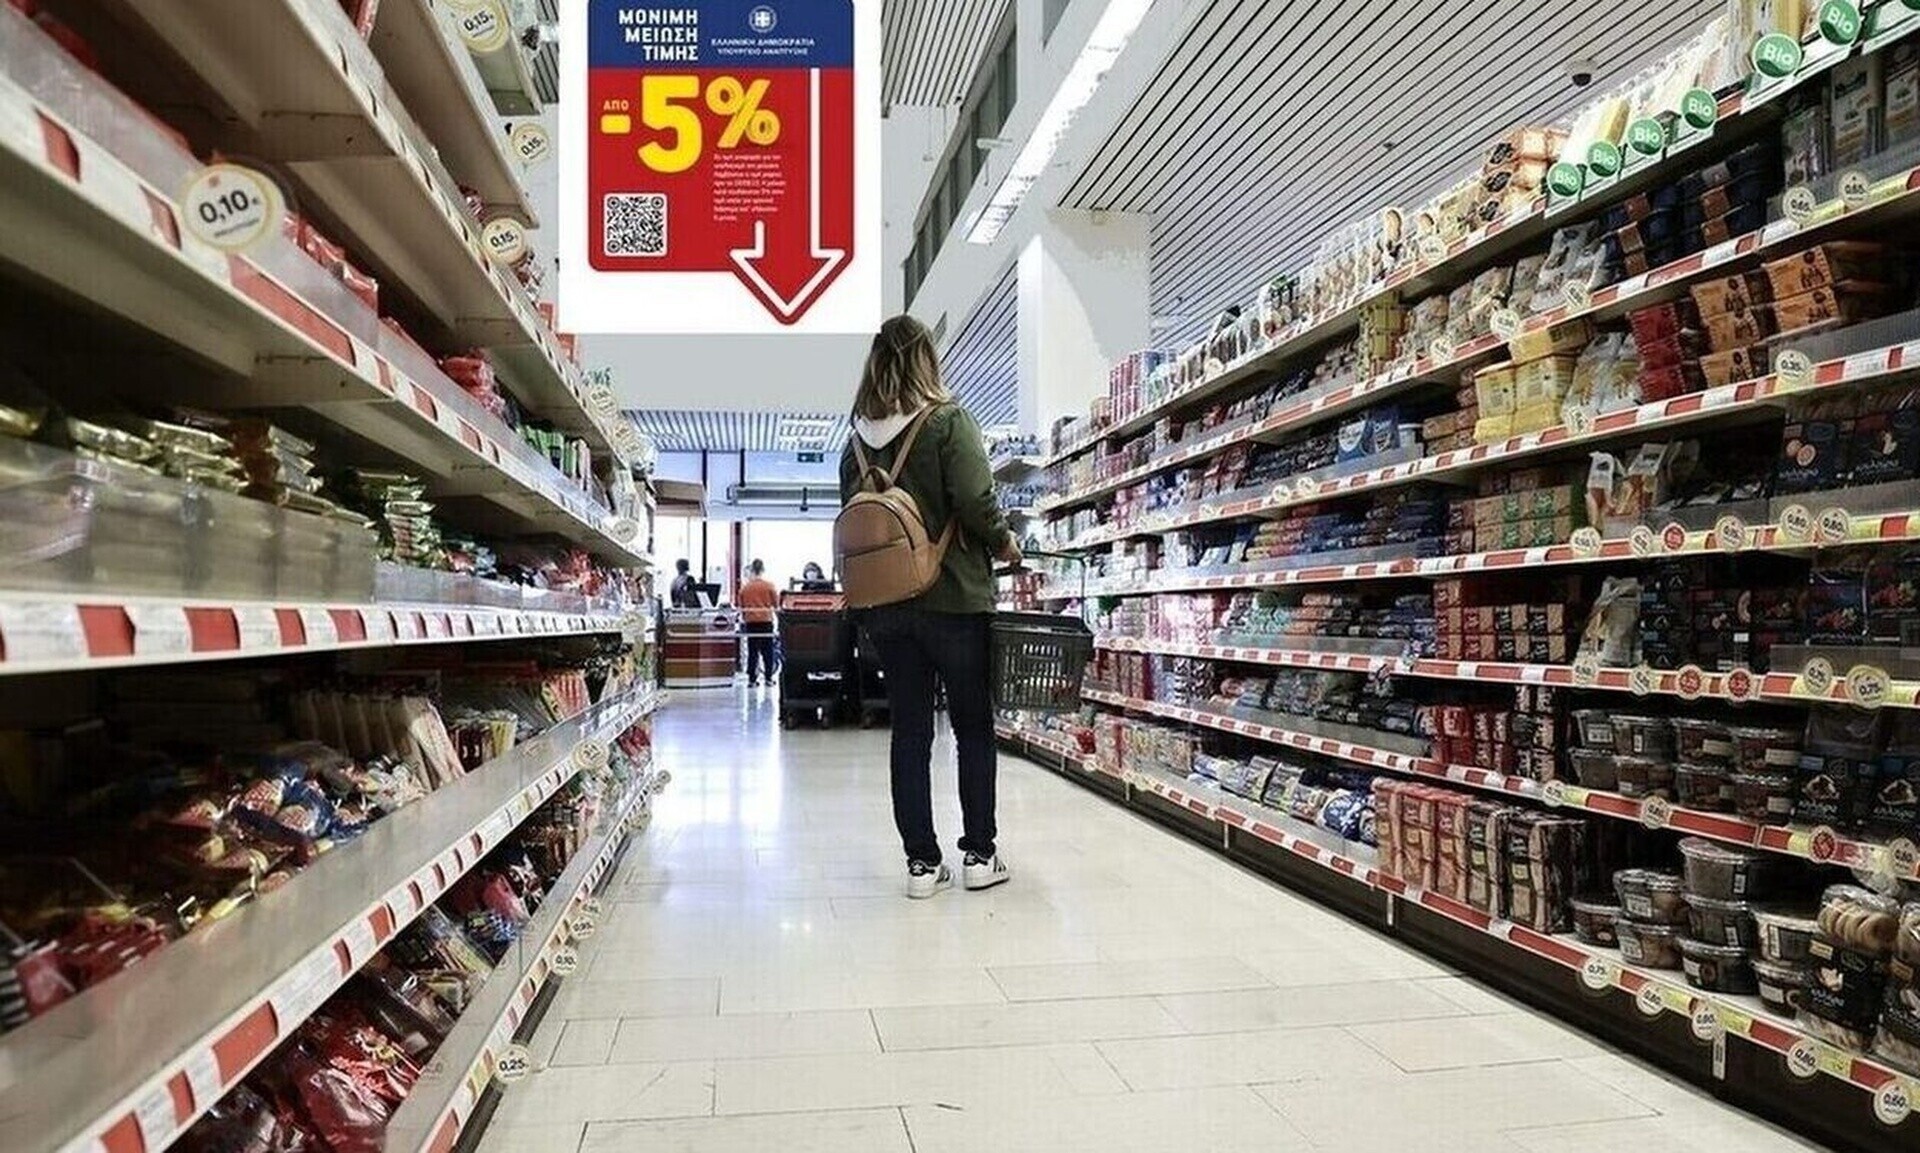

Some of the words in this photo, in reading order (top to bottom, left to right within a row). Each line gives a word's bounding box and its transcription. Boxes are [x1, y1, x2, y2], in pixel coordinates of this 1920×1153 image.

[618, 9, 698, 25] ΜΟΝΙΜΗ
[1826, 7, 1854, 33] Bio
[625, 27, 698, 43] ΜΕΙΩΣΗ
[643, 45, 698, 61] ΤΙΜΗΣ
[1763, 42, 1794, 65] Bio
[603, 99, 630, 111] ΑΠΟ
[1687, 98, 1712, 117] Bio
[601, 75, 781, 173] -5%
[1634, 129, 1660, 142] Bio
